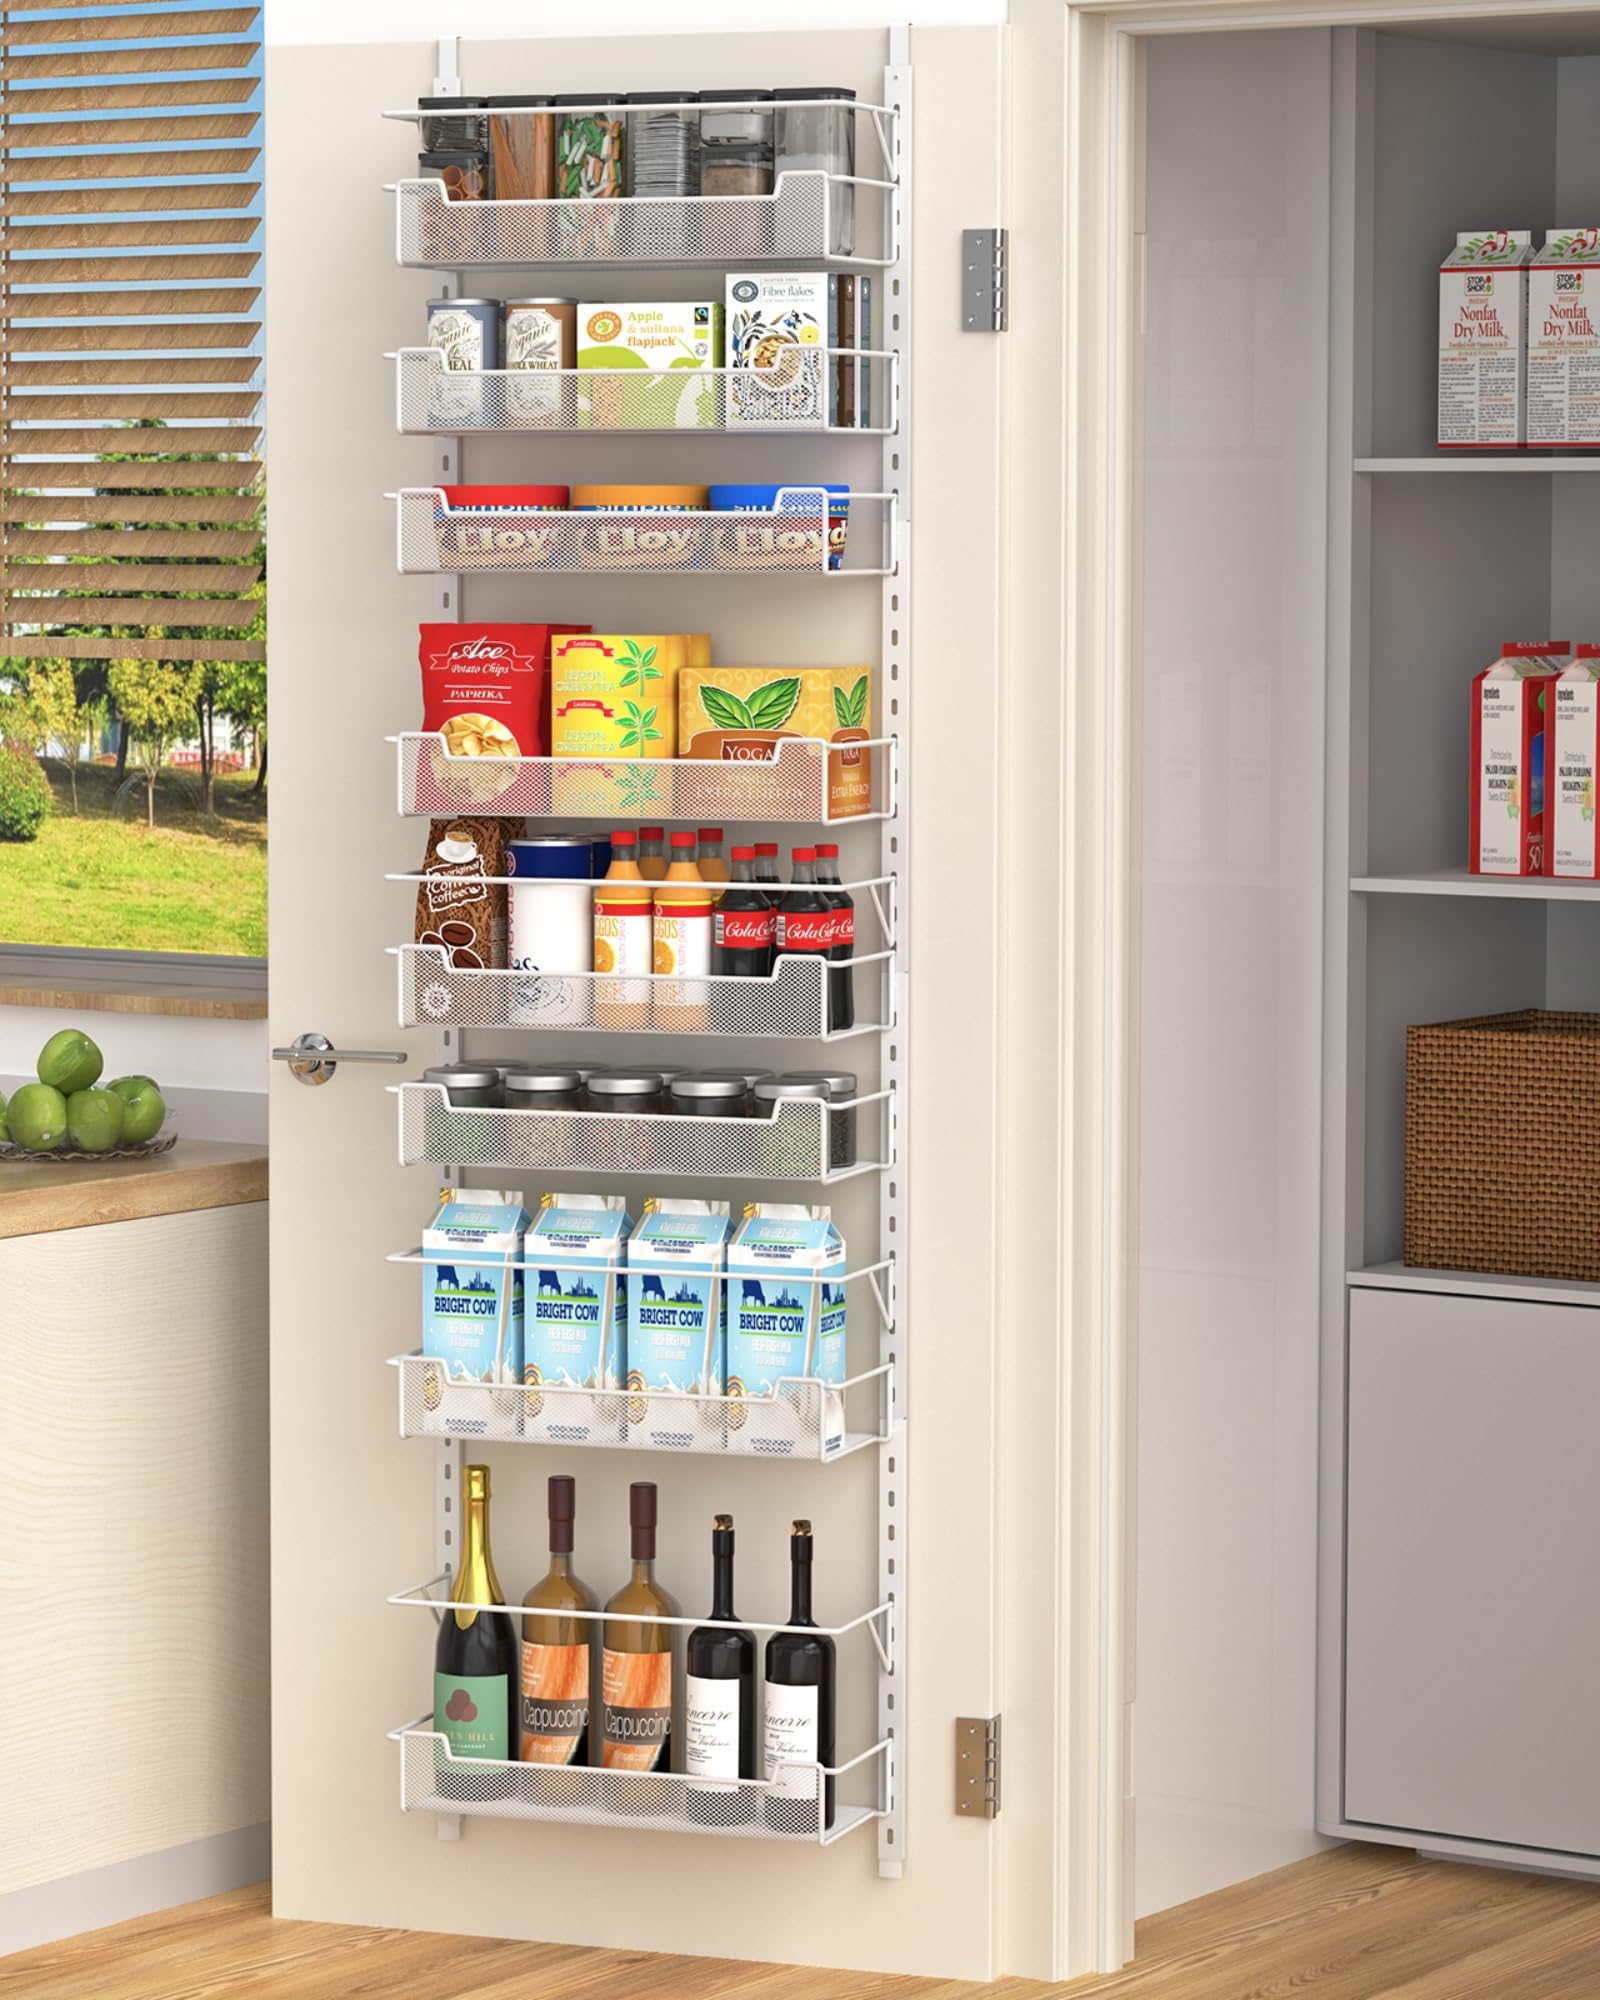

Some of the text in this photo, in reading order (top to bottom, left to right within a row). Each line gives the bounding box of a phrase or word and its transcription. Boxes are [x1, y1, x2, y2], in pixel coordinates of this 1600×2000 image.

[762, 286, 786, 296] Fibre
[788, 285, 815, 296] flakes
[628, 311, 664, 324] Apple
[1460, 306, 1498, 321] Nonfat
[1549, 304, 1588, 319] Nonfat
[640, 324, 685, 334] sultana
[1454, 322, 1504, 341] Dry Milk
[1543, 319, 1594, 340] Dry Milk
[627, 336, 676, 349] flapjack
[528, 361, 558, 370] WHEAT
[452, 636, 509, 659] Ace
[451, 663, 509, 677] Potato Chips
[564, 669, 607, 681] LEMON
[556, 681, 616, 693] GREEN TEA
[450, 690, 504, 700] PAPRIKA
[564, 730, 607, 741] LEMON
[556, 742, 617, 752] GREEN TEA
[726, 746, 775, 761] YOGA
[448, 861, 479, 877] original
[432, 890, 465, 904] coffee
[434, 1297, 472, 1314] BRIGHT
[472, 1299, 497, 1316] COW
[536, 1302, 573, 1320] BRIGHT
[574, 1304, 599, 1321] COW
[639, 1308, 678, 1327] BRIGHT
[679, 1310, 704, 1328] COW
[739, 1313, 778, 1332] BRIGHT
[779, 1315, 805, 1333] COW
[523, 1699, 590, 1733] Cappuccino
[604, 1707, 672, 1741] Cappuccino
